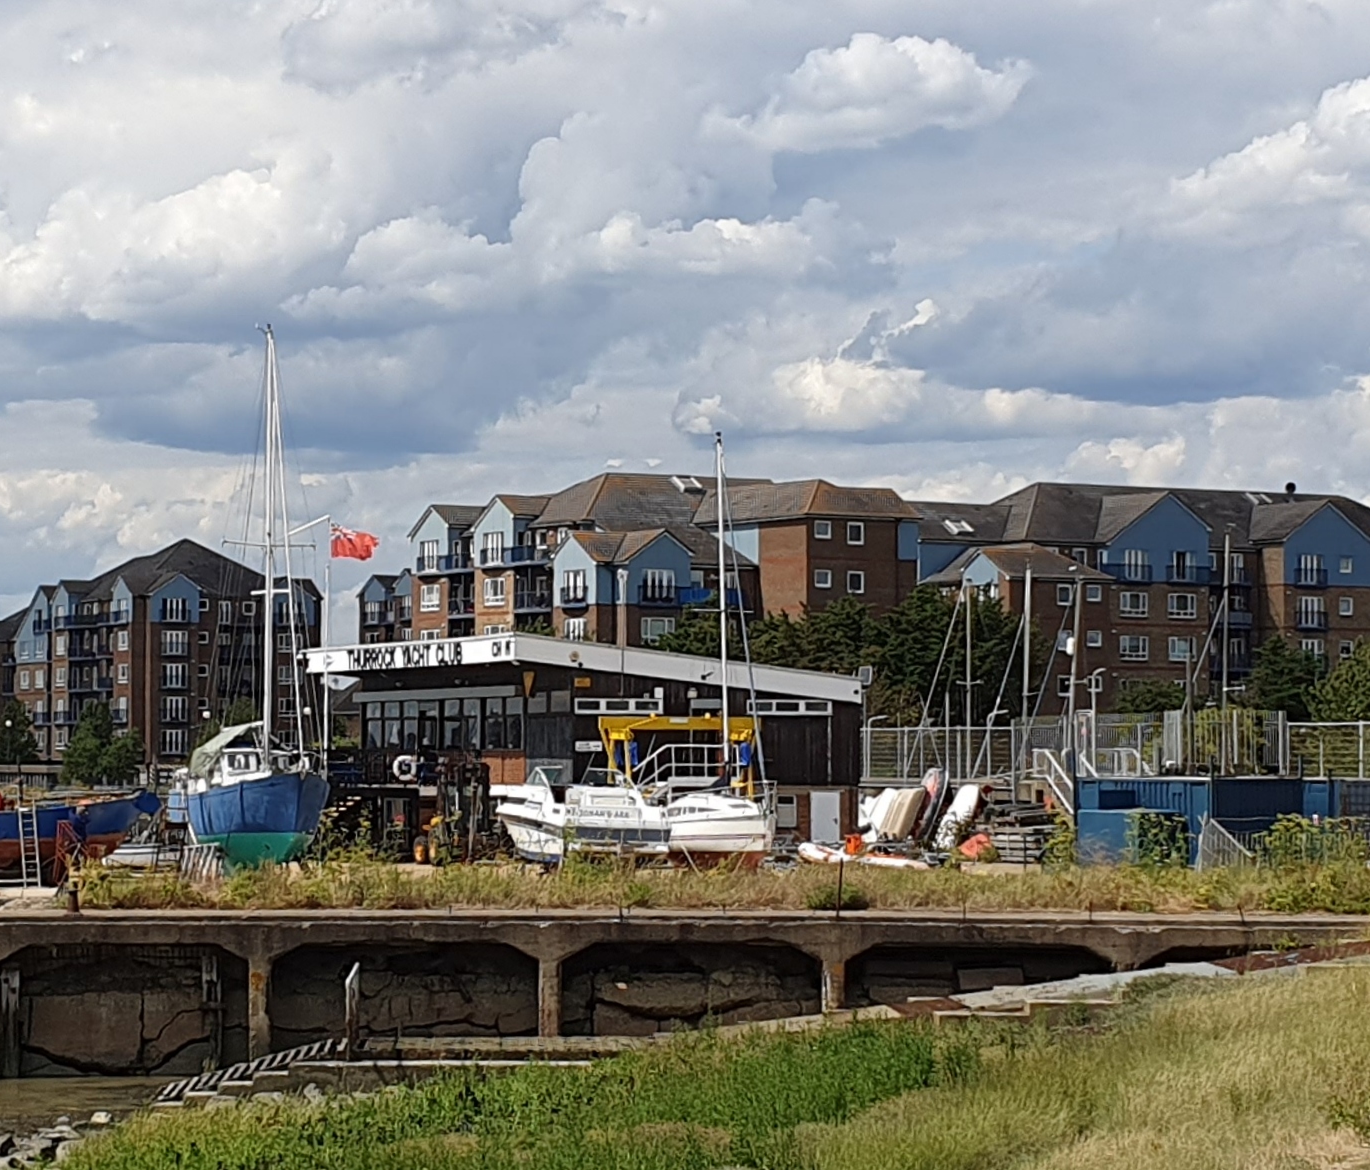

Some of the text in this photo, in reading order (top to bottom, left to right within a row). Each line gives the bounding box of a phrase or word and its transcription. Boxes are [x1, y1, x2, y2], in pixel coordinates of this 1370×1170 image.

[347, 642, 462, 670] THURROCK YACHT CLUB
